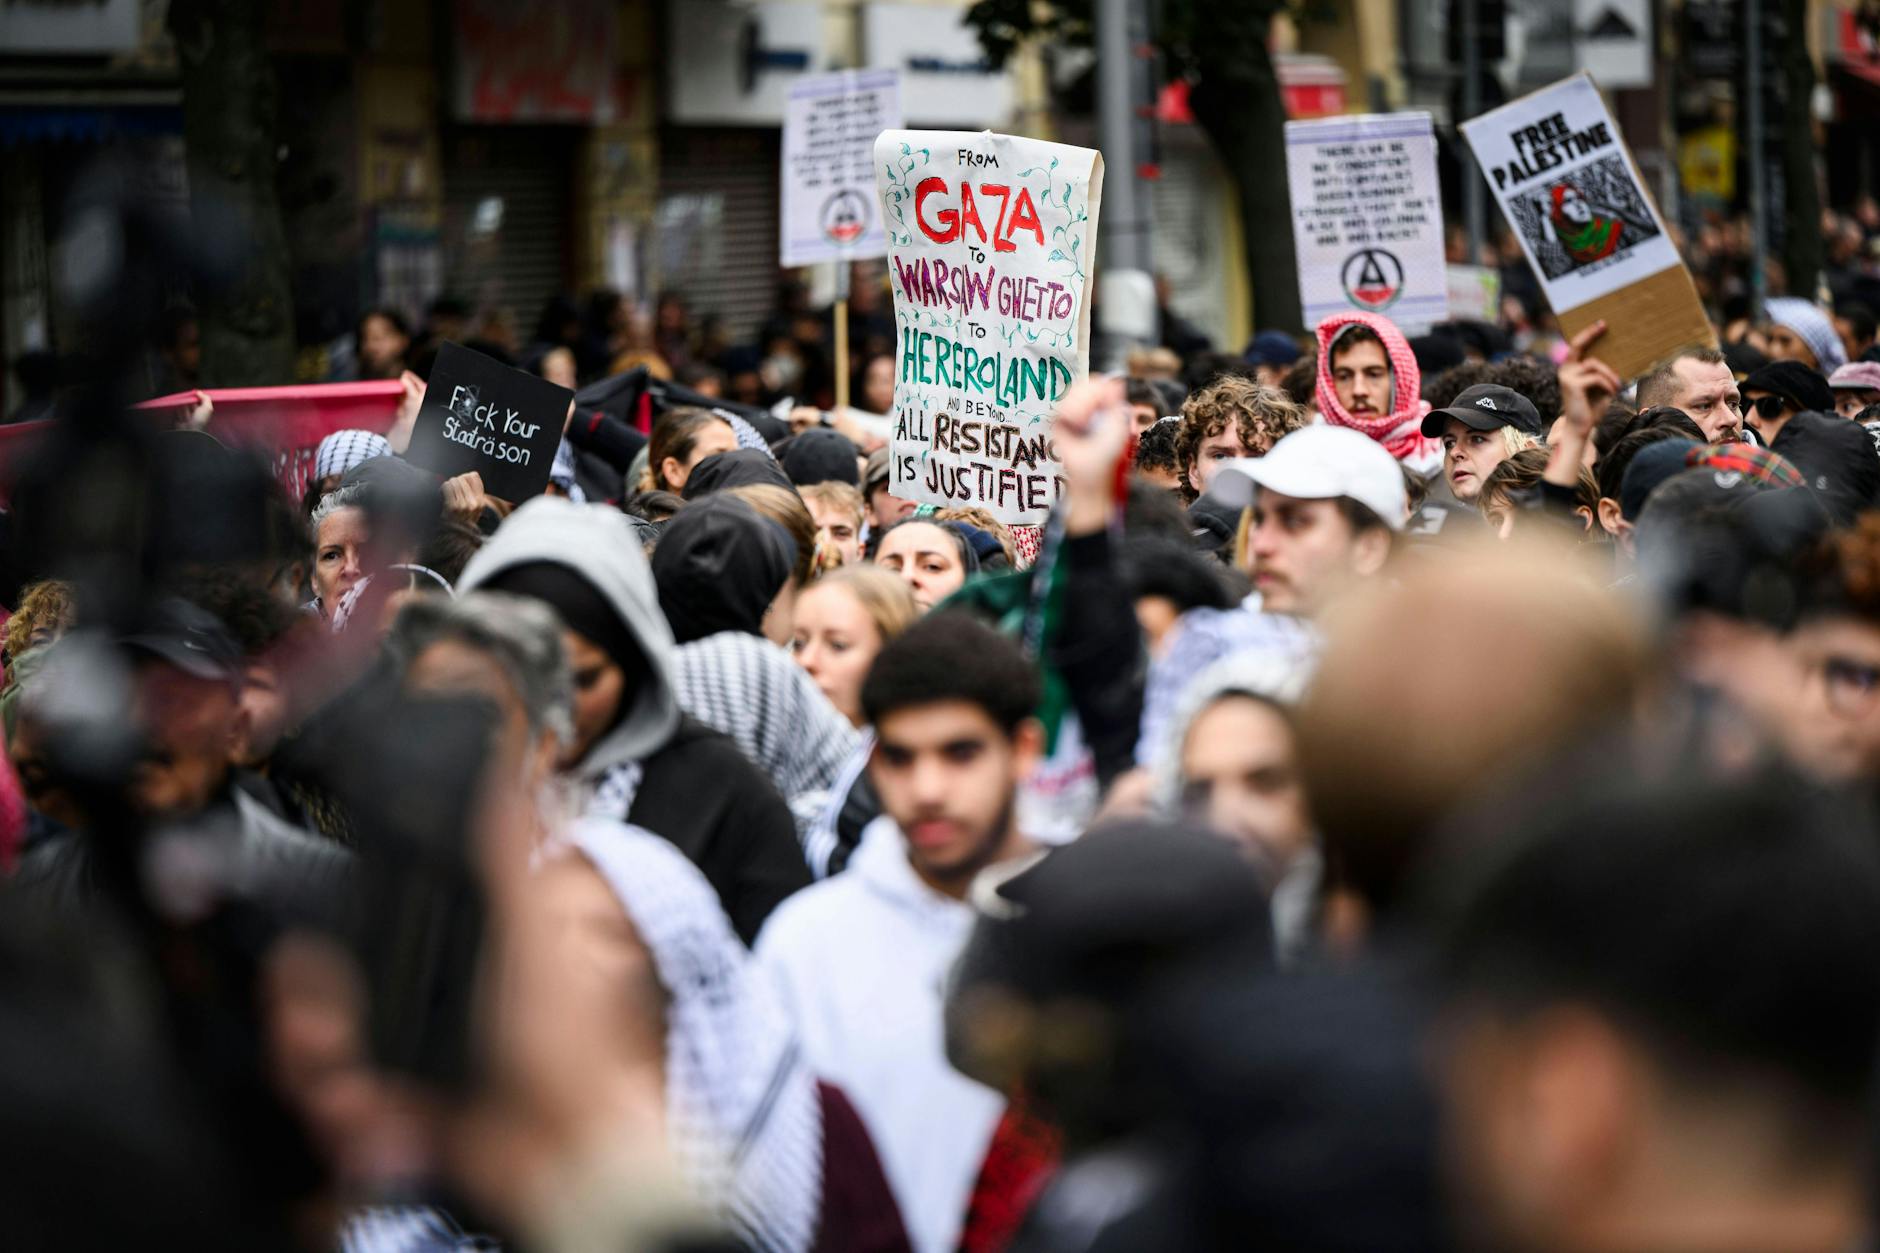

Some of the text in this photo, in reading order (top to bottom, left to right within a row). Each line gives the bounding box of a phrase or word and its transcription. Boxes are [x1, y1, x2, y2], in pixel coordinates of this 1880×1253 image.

[958, 149, 998, 168] FROM
[1491, 121, 1613, 190] PALESTINE
[1510, 110, 1571, 157] FREE
[915, 177, 1045, 253] GAZA
[968, 246, 986, 264] TO
[894, 255, 1073, 322] WARSAW GHETTO
[968, 322, 986, 339] TO
[902, 326, 1072, 408] HEREROLAND
[449, 385, 541, 438] Fck Your
[947, 396, 960, 412] AND
[443, 416, 531, 466] Staaträson
[896, 408, 1063, 470] ALL RESISTANC
[898, 455, 916, 482] IS
